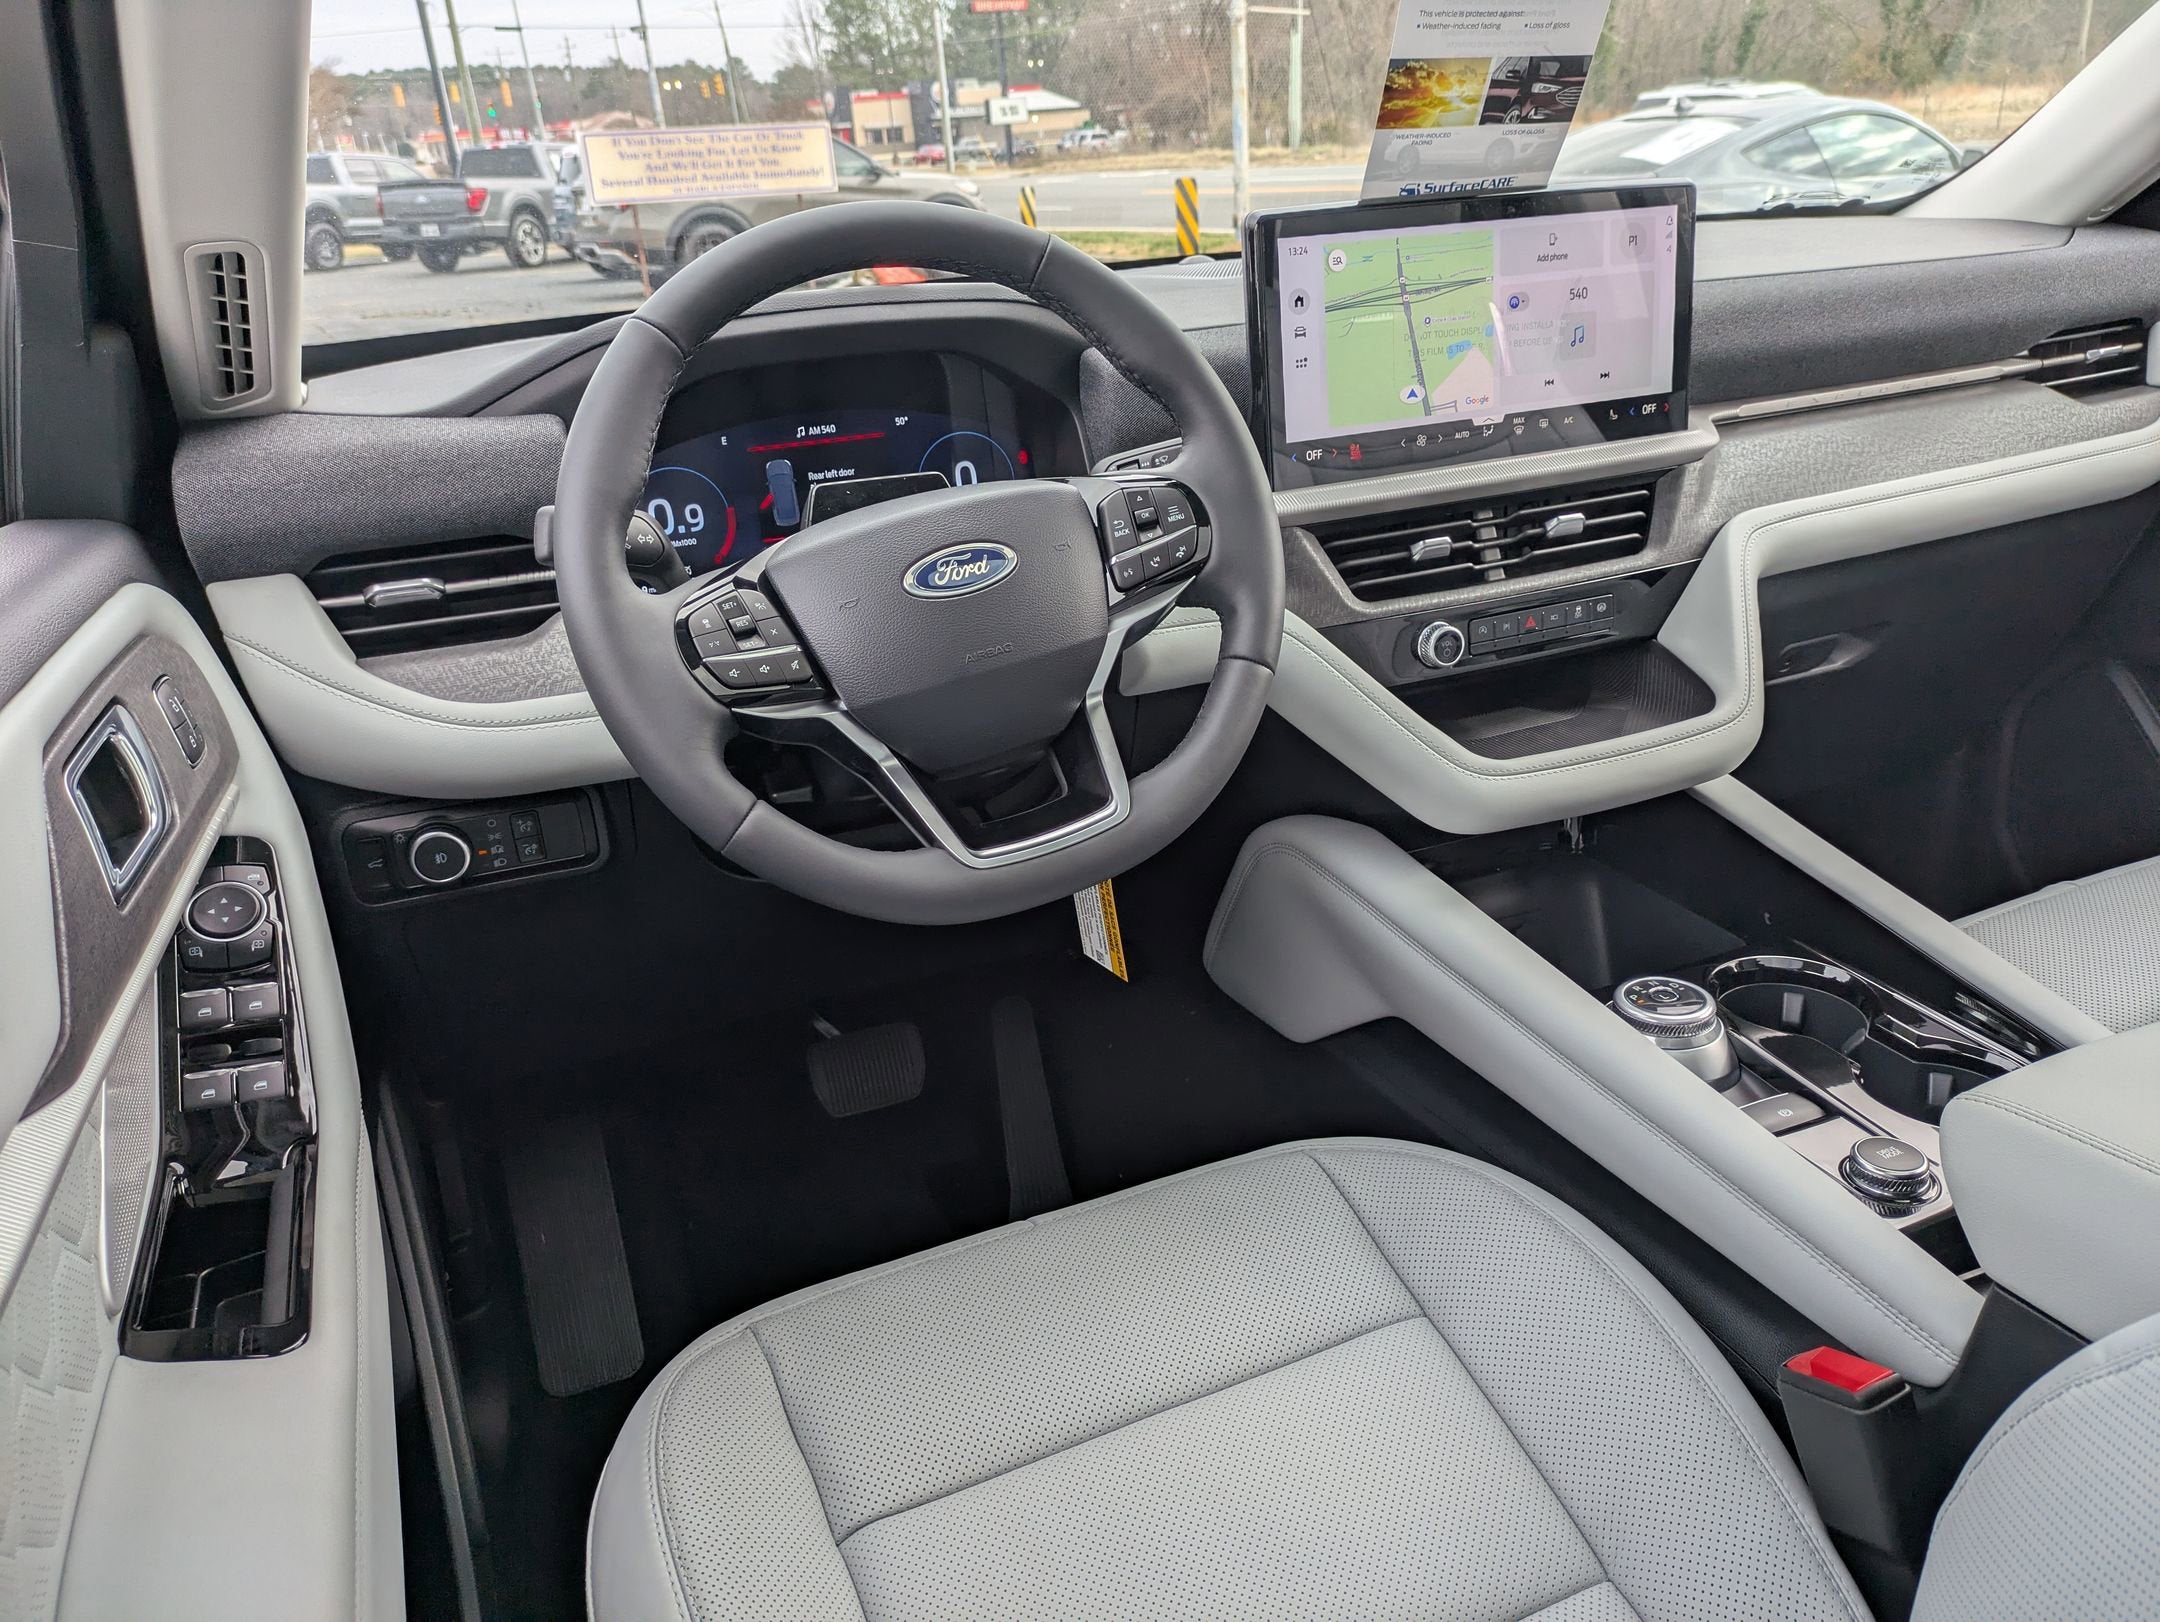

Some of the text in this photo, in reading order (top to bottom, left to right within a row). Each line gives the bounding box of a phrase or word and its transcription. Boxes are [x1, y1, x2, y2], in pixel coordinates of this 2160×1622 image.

[1434, 10, 1458, 18] vehicle
[1465, 10, 1498, 19] protected
[1480, 22, 1501, 31] fading
[1552, 22, 1570, 30] gloss
[1396, 132, 1452, 140] WEATHER-INDUCED
[1424, 176, 1515, 194] SurfaceCARE
[1628, 235, 1638, 246] P1
[1288, 246, 1308, 256] 13:24
[1537, 252, 1568, 262] Add phone
[1570, 287, 1588, 300] 540
[1465, 395, 1489, 405] Google
[1642, 403, 1657, 415] OFF
[895, 416, 908, 426] 50°
[1512, 416, 1525, 424] MAX
[1564, 416, 1574, 424] A/C
[808, 424, 836, 436] AM 540
[1454, 430, 1470, 439] AUTO
[721, 436, 728, 446] E
[1306, 448, 1322, 461] OFF
[808, 468, 856, 481] Rear left door
[648, 498, 704, 536] 0.9
[1167, 512, 1185, 522] MENU
[1114, 528, 1130, 538] BACK
[934, 552, 991, 586] Ford
[736, 620, 749, 628] RES
[964, 642, 1014, 665] AIRBAG
